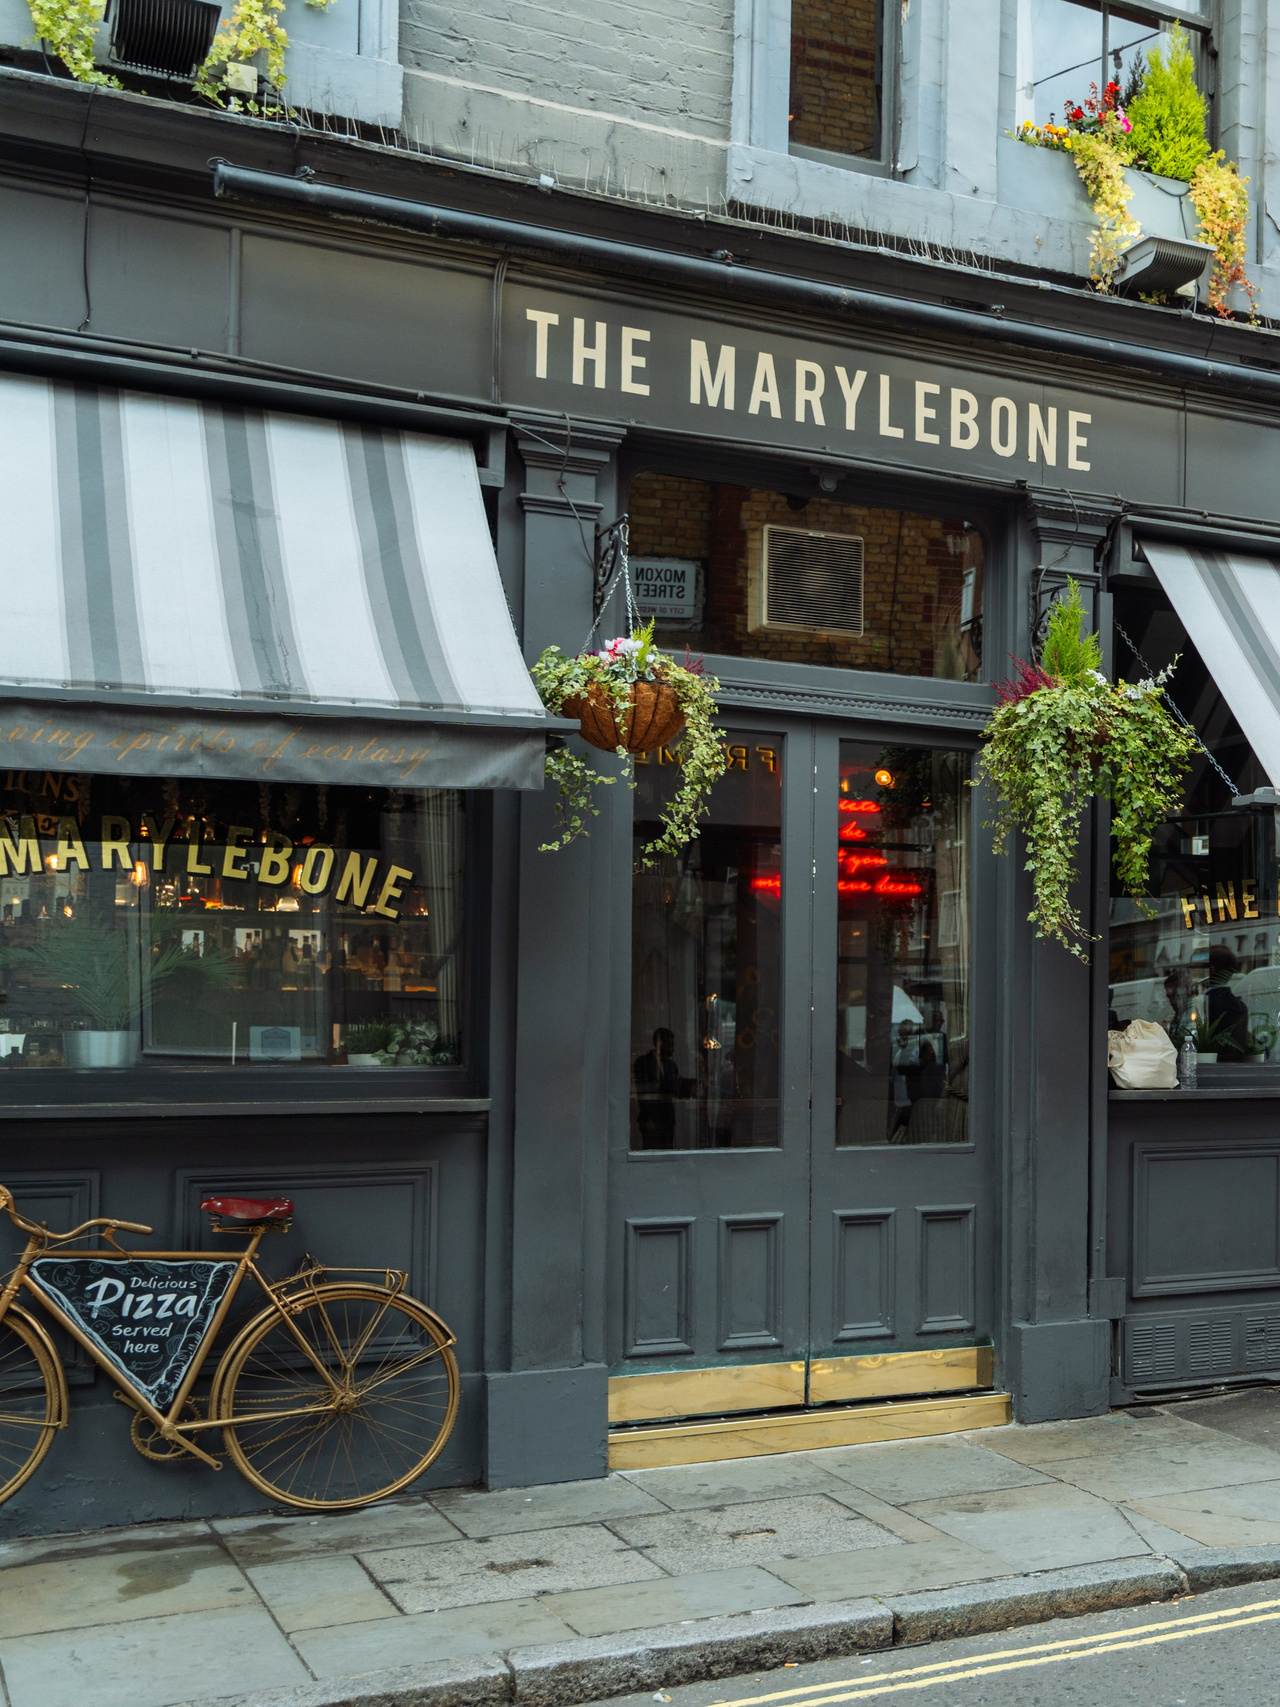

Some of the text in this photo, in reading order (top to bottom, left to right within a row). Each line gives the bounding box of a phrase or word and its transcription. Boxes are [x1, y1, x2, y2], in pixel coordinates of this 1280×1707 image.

[526, 309, 1092, 472] THE MARYLEBONE
[102, 726, 236, 761] spirits
[248, 725, 302, 772] of
[300, 737, 431, 779] ecstasy
[0, 815, 414, 919] MARYLEBONE
[849, 855, 889, 874] you
[838, 875, 923, 893] ave been
[1179, 878, 1260, 929] FINE
[130, 1276, 197, 1289] Delicious
[85, 1277, 198, 1320] Pizza
[112, 1322, 174, 1338] served
[123, 1340, 160, 1354] here
